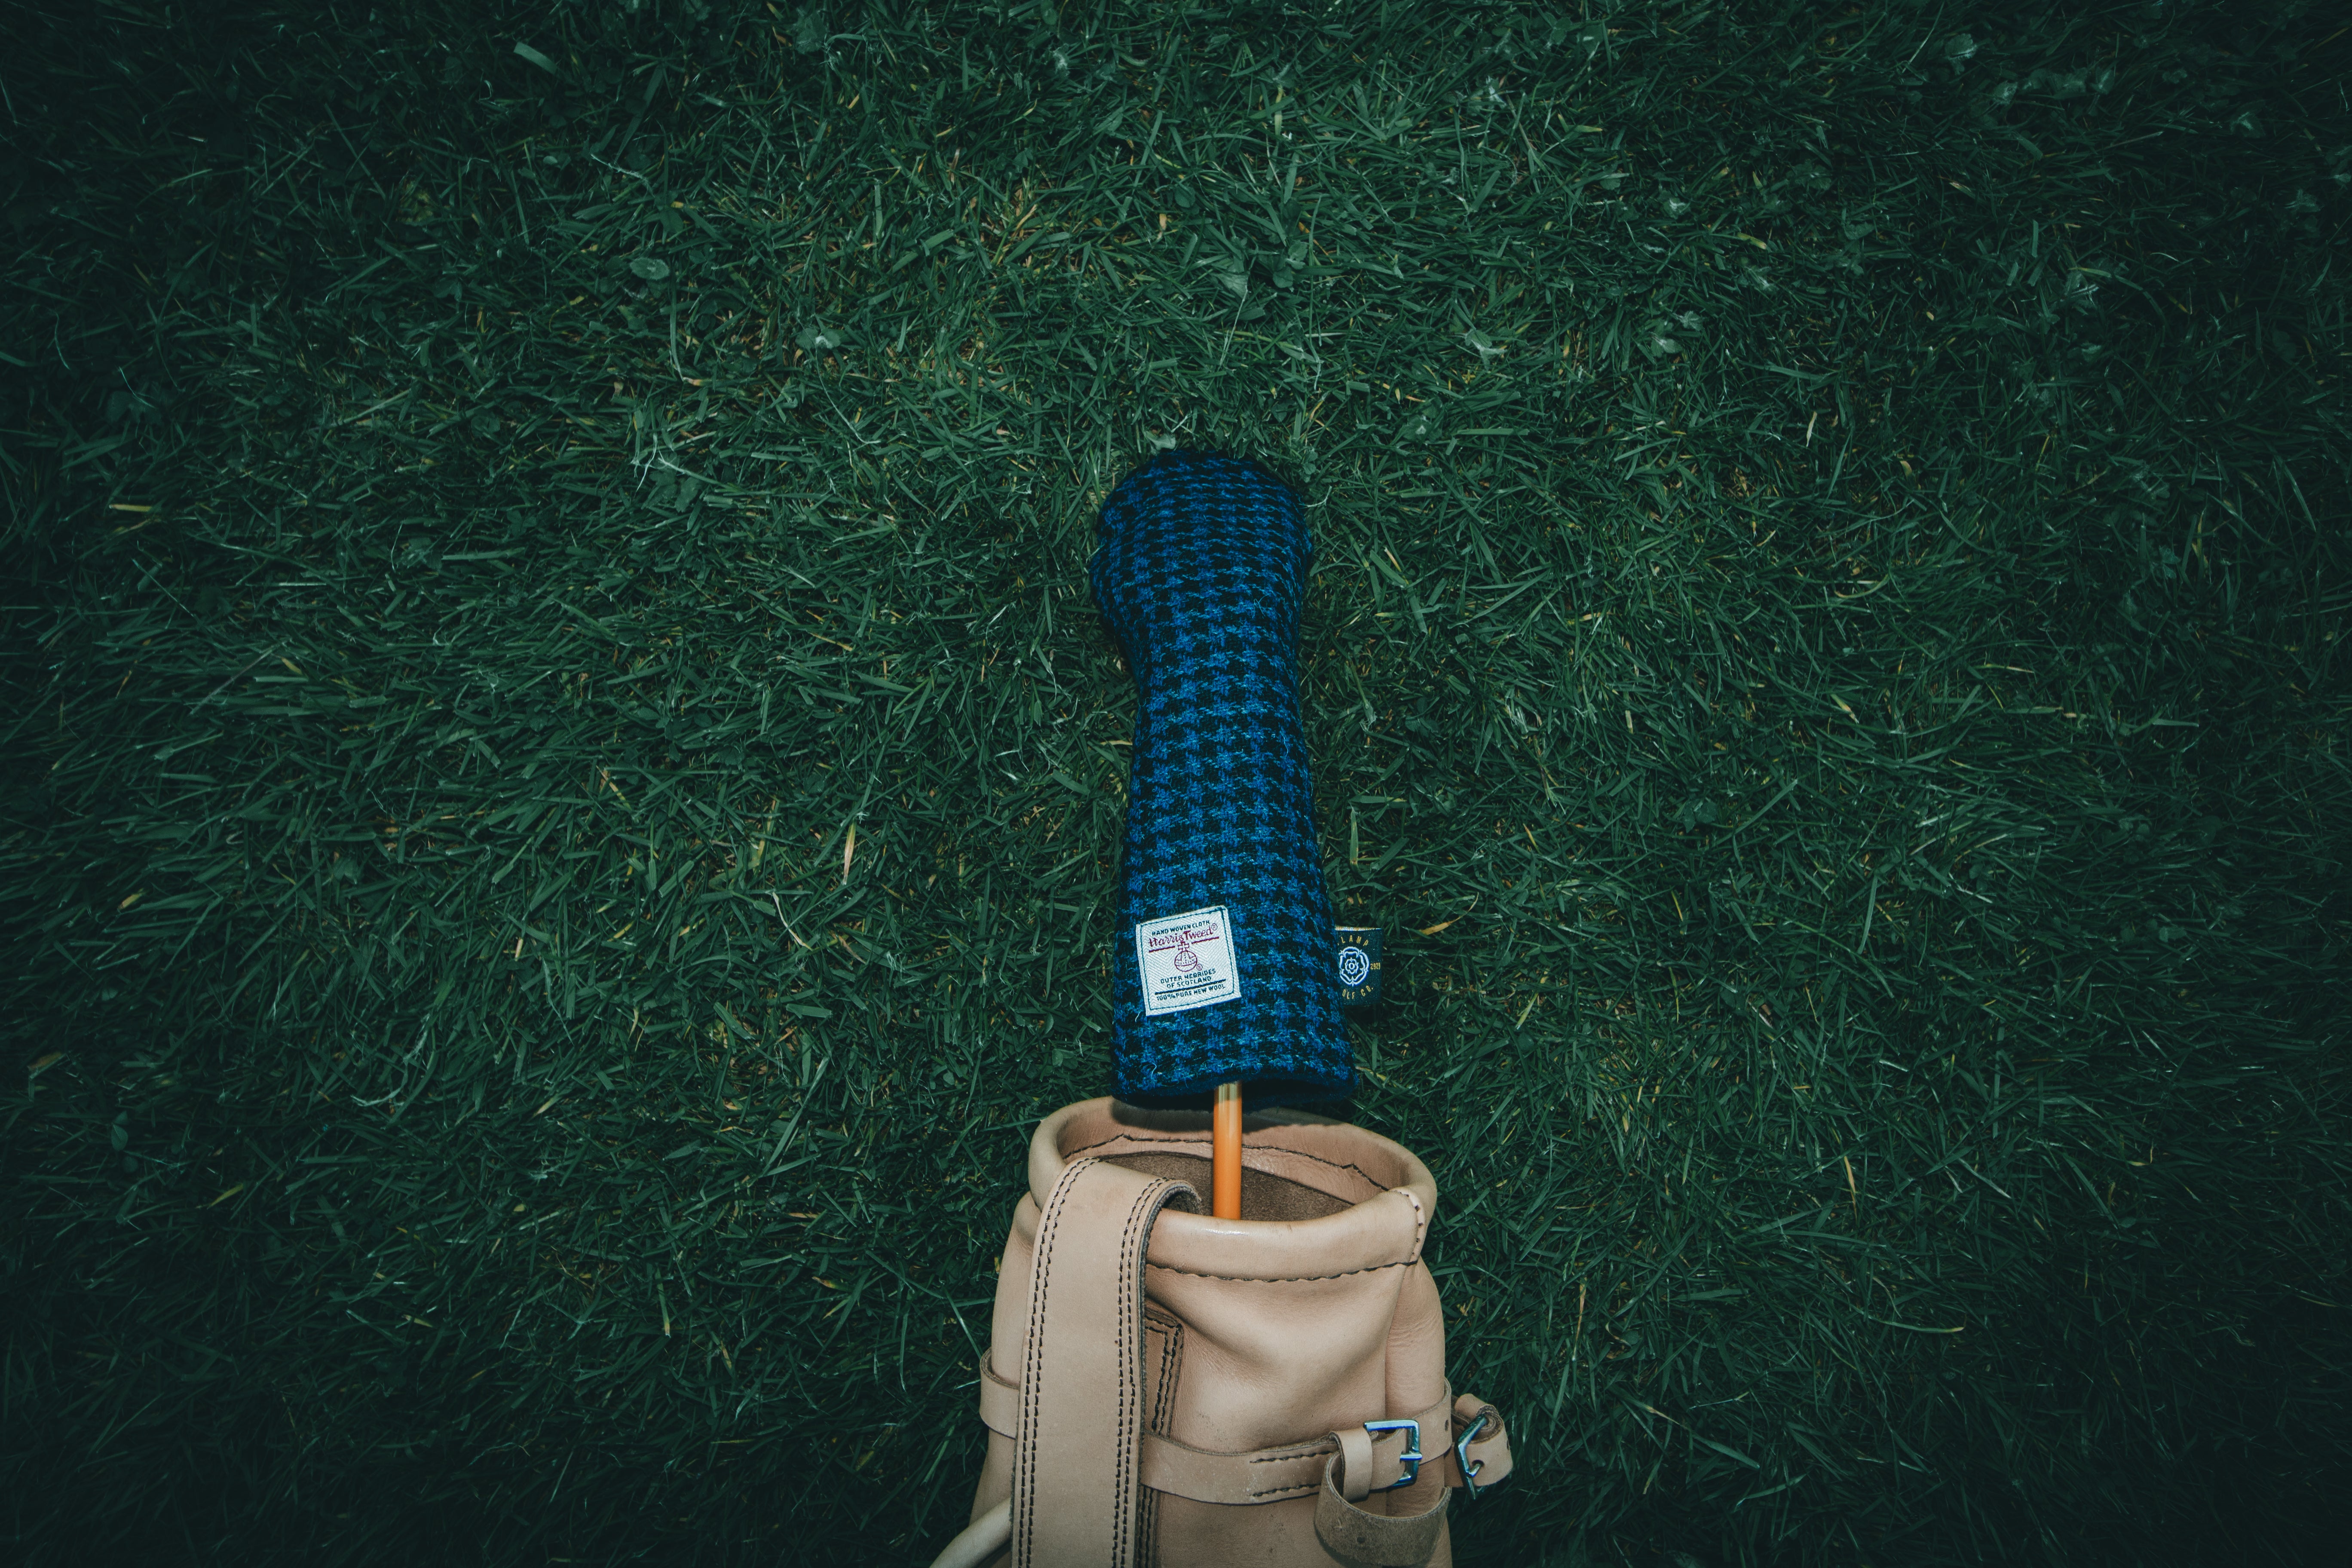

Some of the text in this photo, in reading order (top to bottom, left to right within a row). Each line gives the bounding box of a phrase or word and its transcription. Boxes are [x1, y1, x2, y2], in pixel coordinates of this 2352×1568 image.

[1170, 924, 1191, 932] WOVEN
[1192, 920, 1210, 928] CLOTH
[1148, 933, 1183, 947] Harris
[1338, 935, 1369, 946] LAMP
[1161, 968, 1216, 984] OUTER HEBRIDES
[1177, 976, 1212, 987] SCOTLAND
[1342, 989, 1355, 999] OLF
